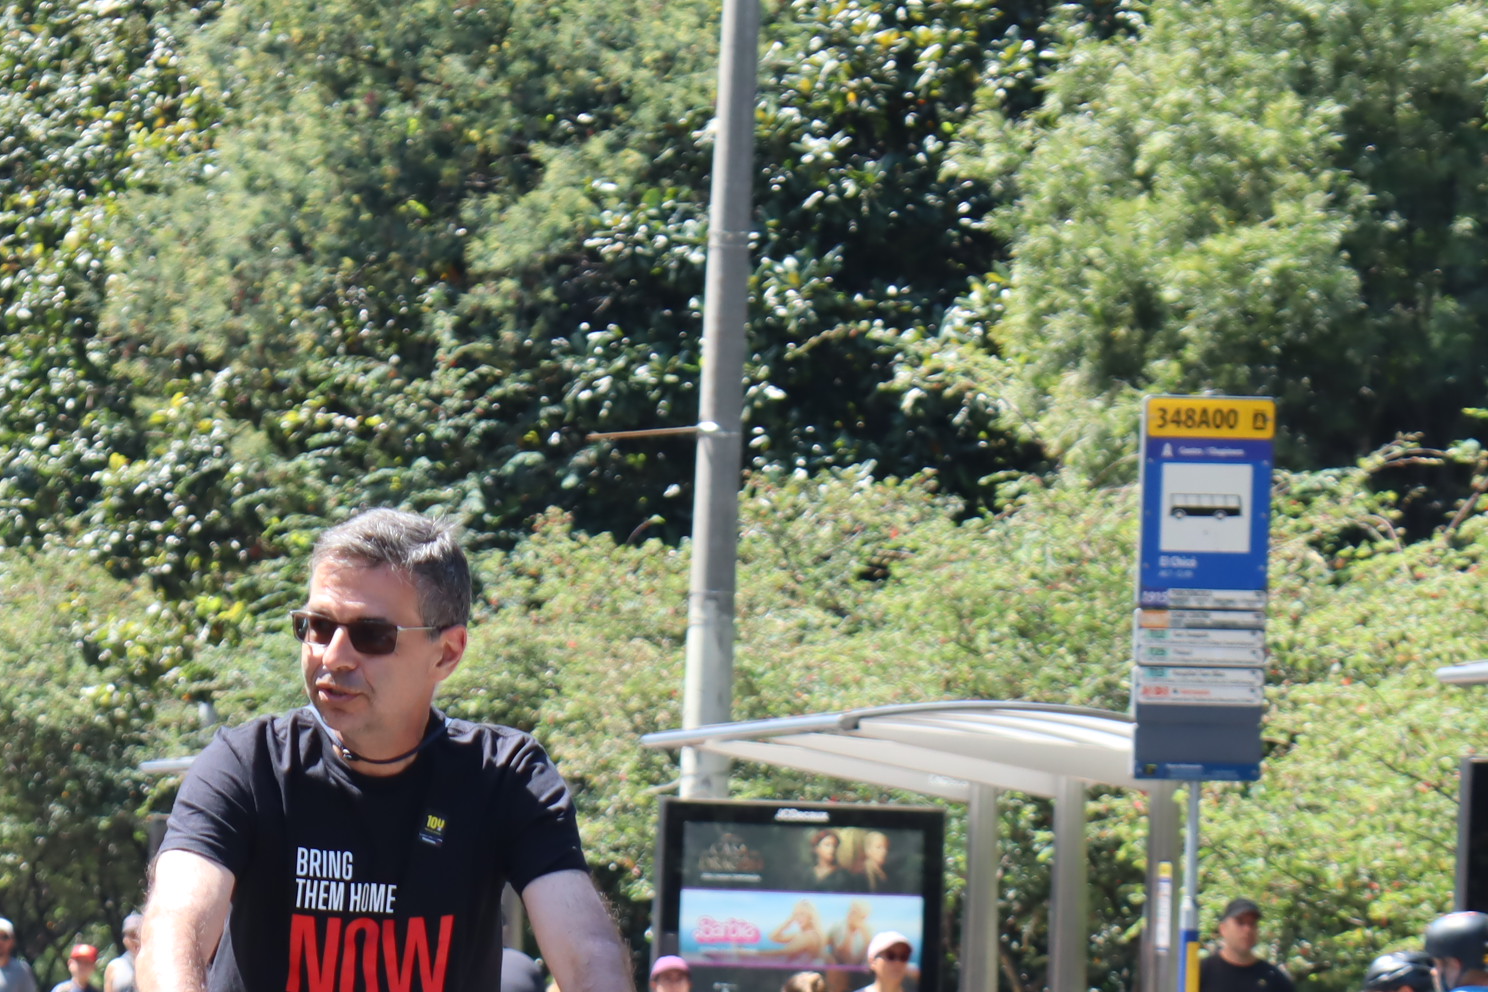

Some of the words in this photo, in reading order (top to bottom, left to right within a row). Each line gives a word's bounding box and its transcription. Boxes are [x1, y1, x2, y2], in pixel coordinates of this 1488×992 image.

[1157, 407, 1238, 429] 348A00
[296, 847, 353, 881] BRING
[295, 878, 345, 912] THEM
[349, 883, 397, 914] HOME
[694, 915, 761, 943] Barbie
